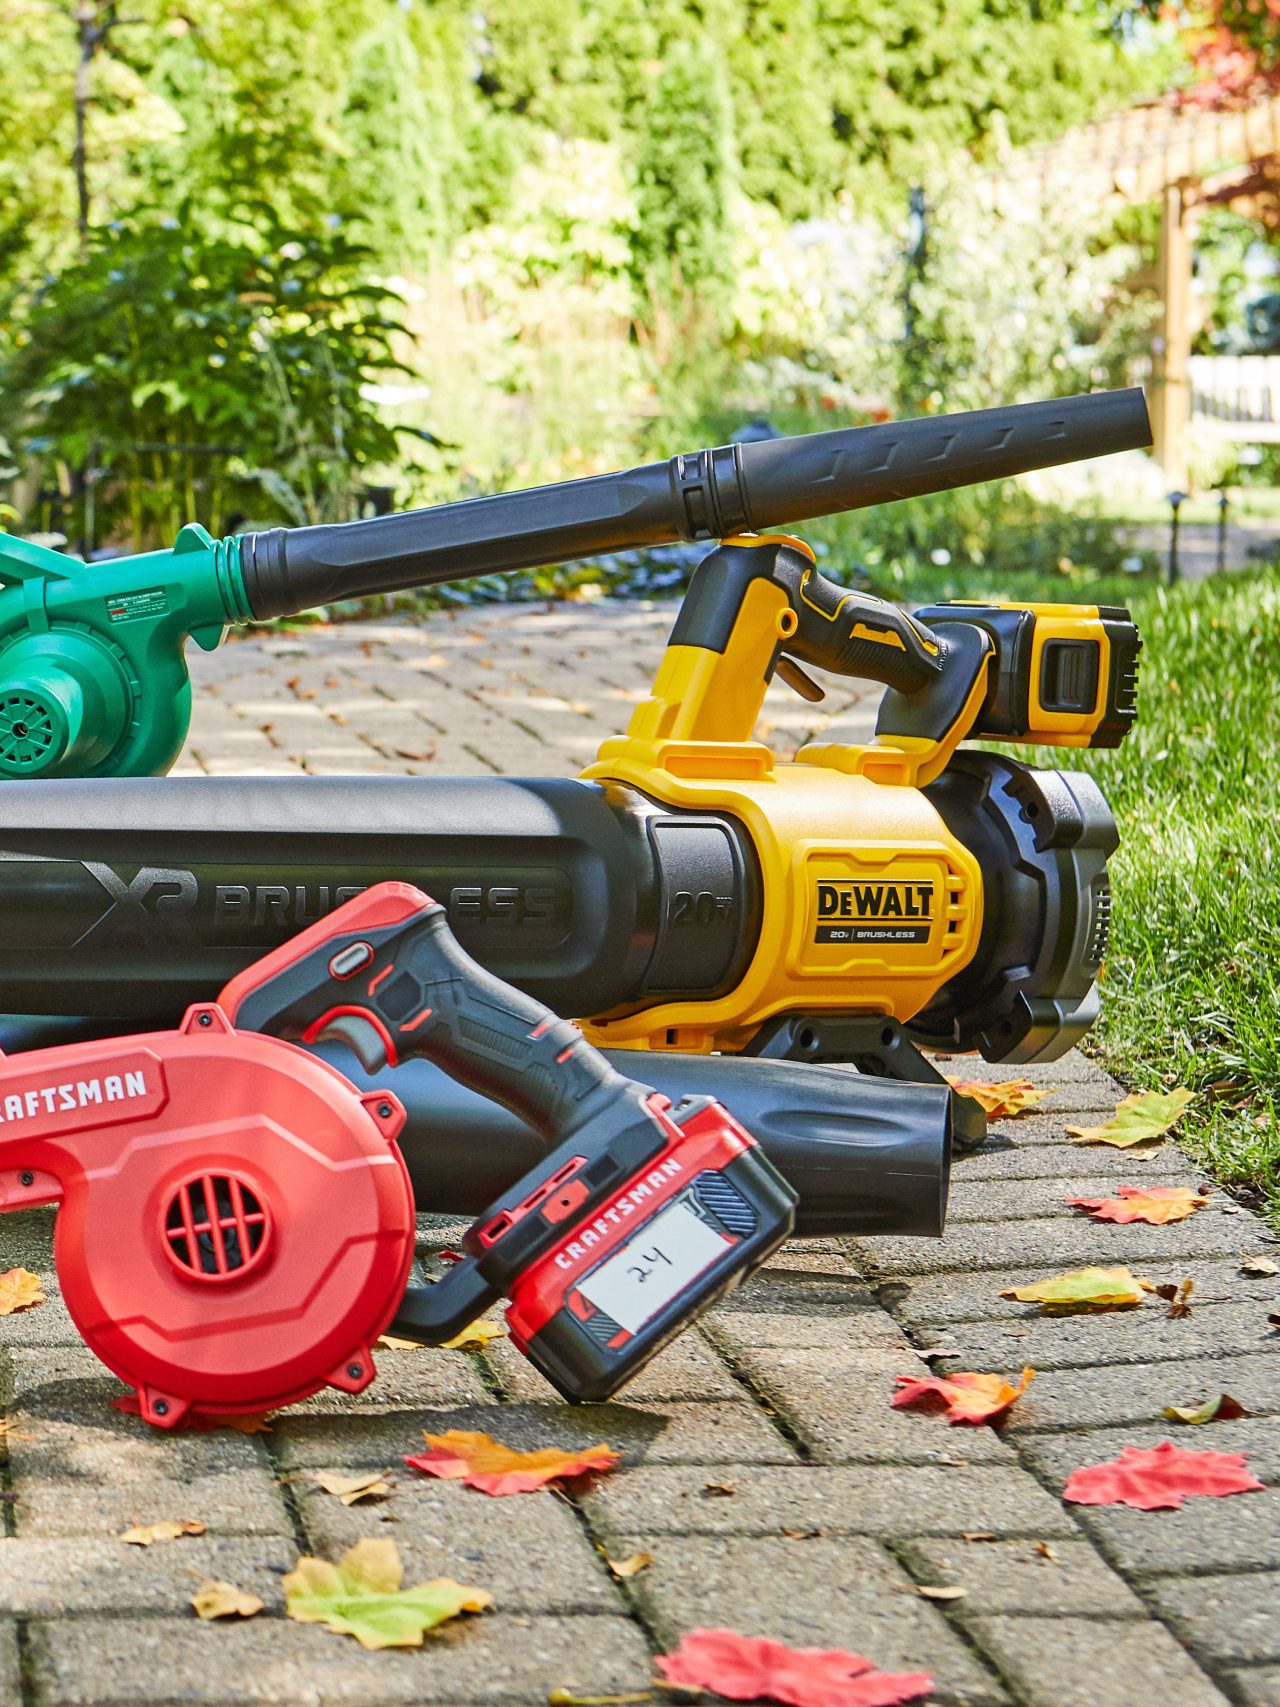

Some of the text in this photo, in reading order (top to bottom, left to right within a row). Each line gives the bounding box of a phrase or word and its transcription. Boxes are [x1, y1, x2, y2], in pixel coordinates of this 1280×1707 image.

[75, 860, 199, 946] XR
[554, 1157, 683, 1270] CRAFTSMAN
[627, 1246, 673, 1283] 24
